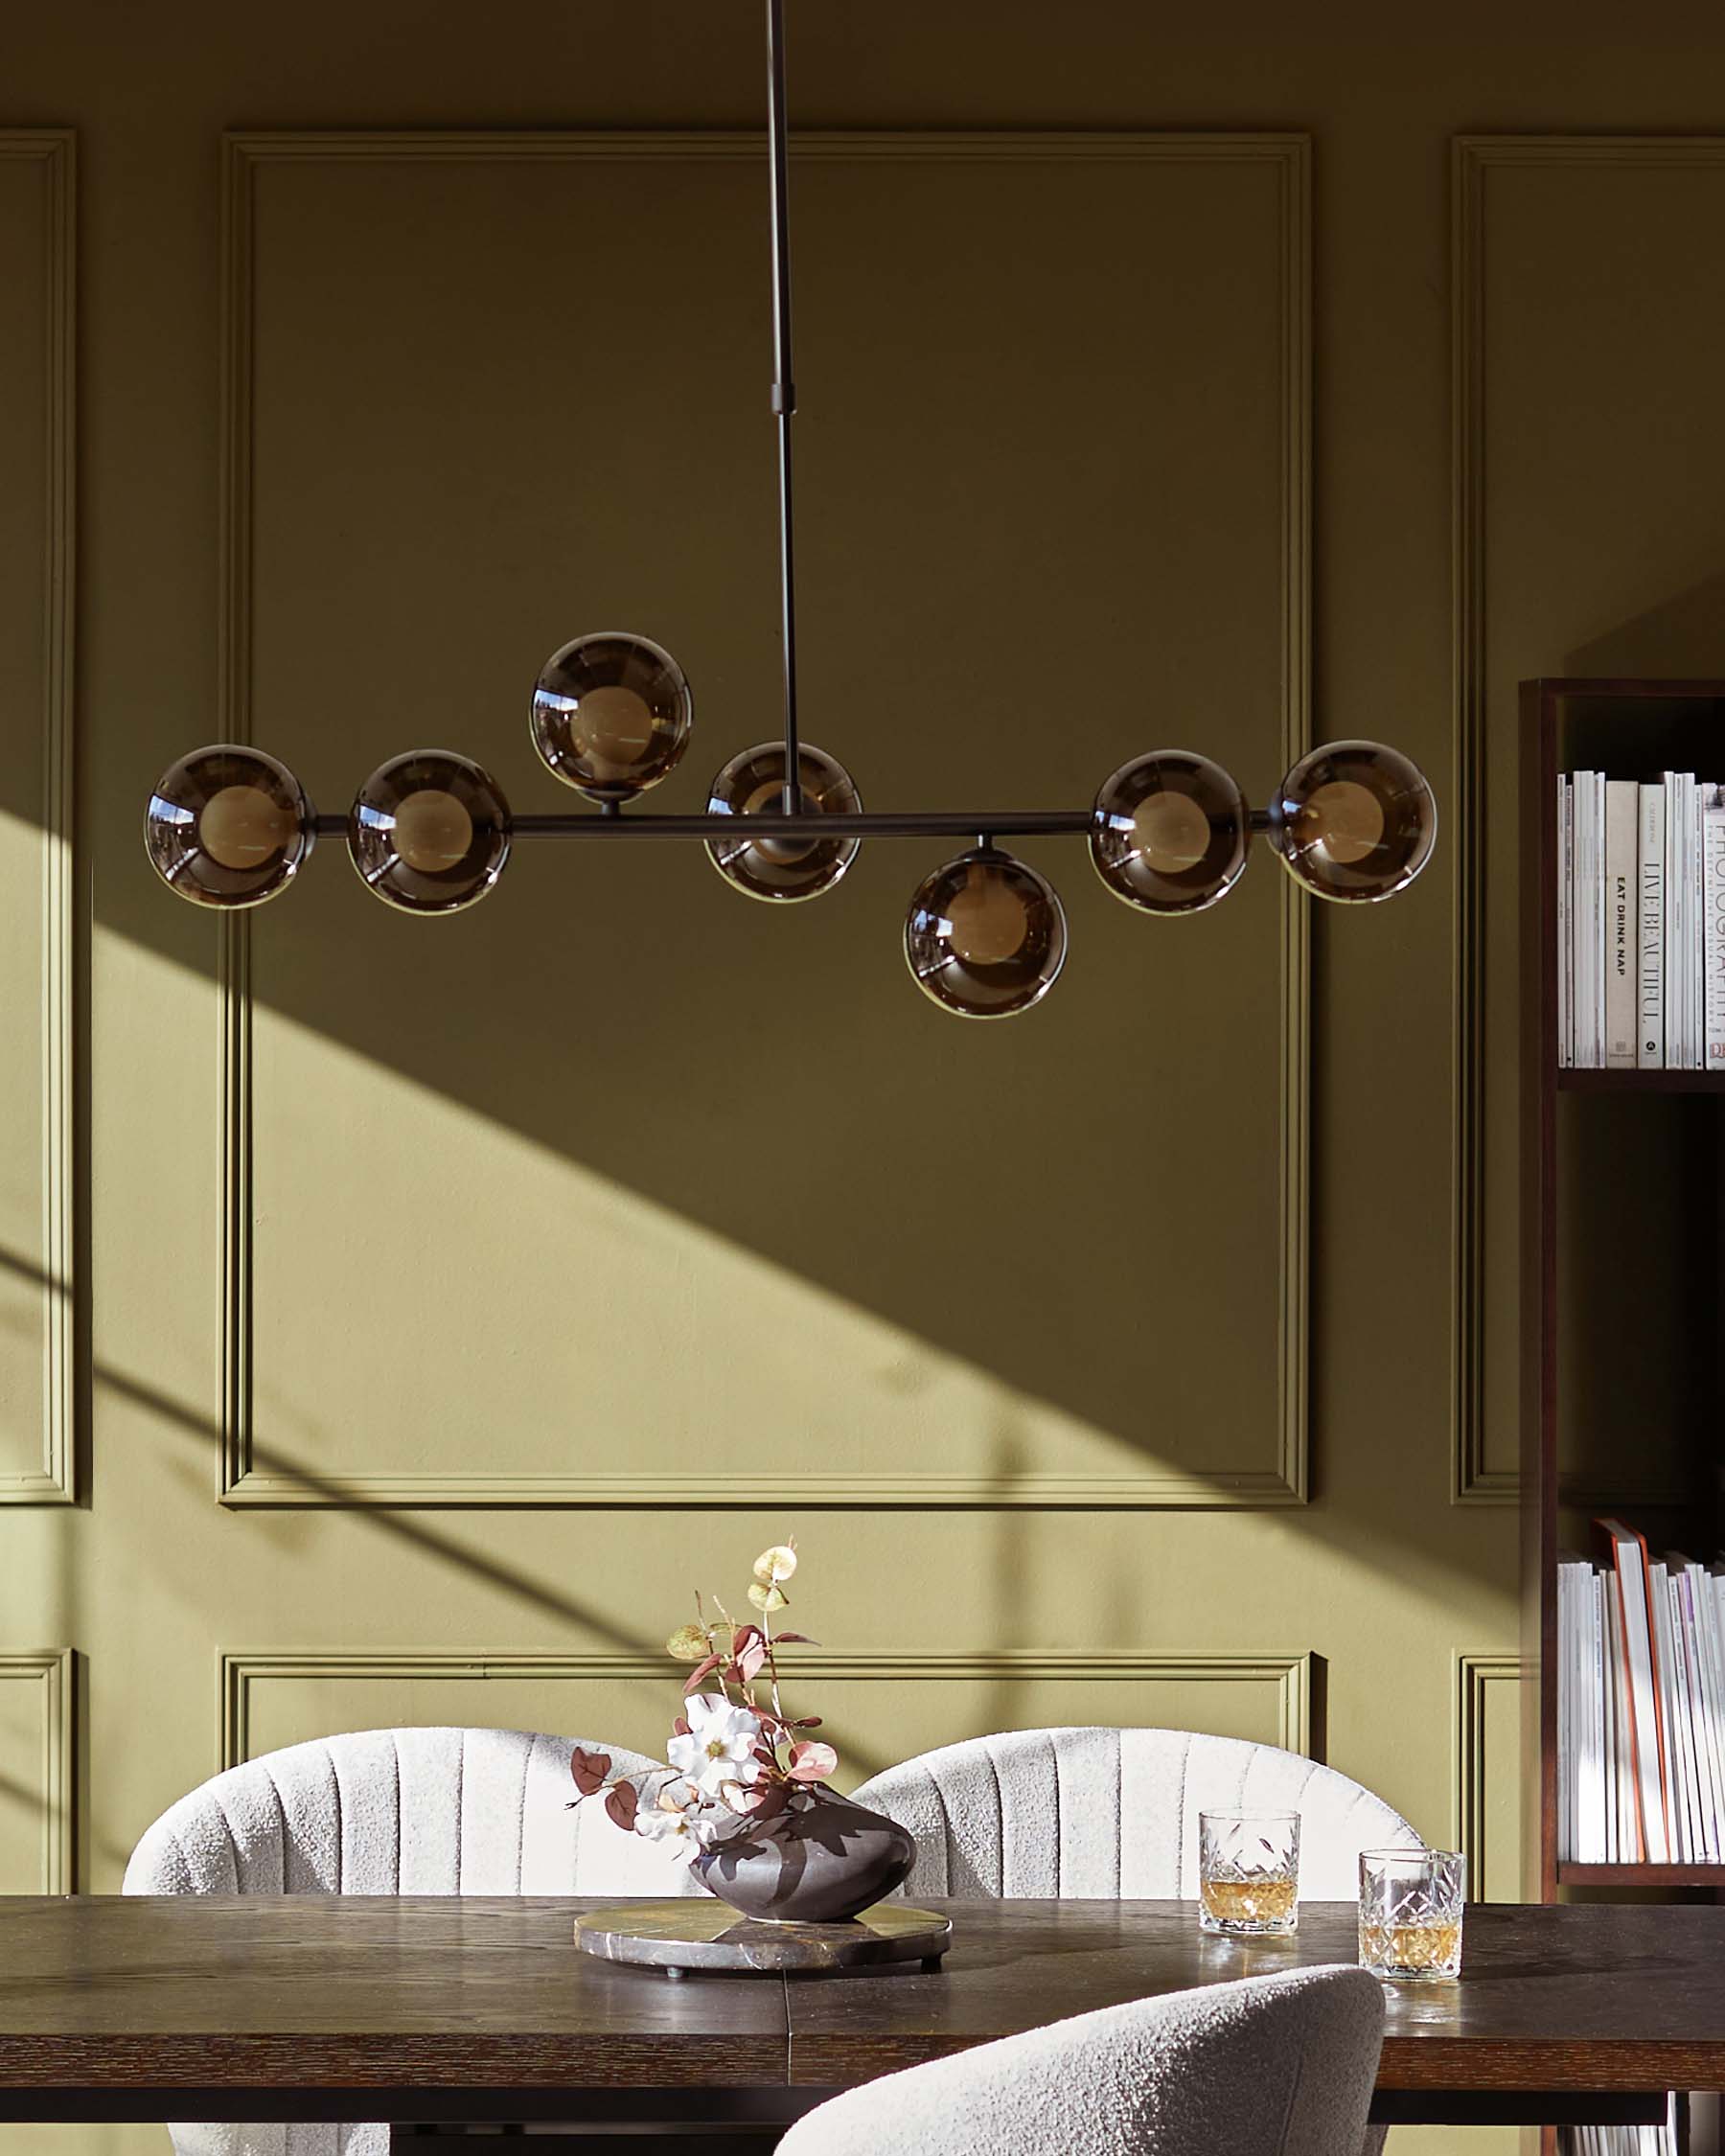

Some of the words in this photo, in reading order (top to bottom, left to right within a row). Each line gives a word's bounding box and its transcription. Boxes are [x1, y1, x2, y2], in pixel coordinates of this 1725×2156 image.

[1617, 877, 1625, 901] EAT
[1644, 863, 1660, 906] LIVE
[1617, 905, 1625, 945] DRINK
[1617, 950, 1625, 975] NAP
[1643, 913, 1659, 1023] BEAUTIFUL
